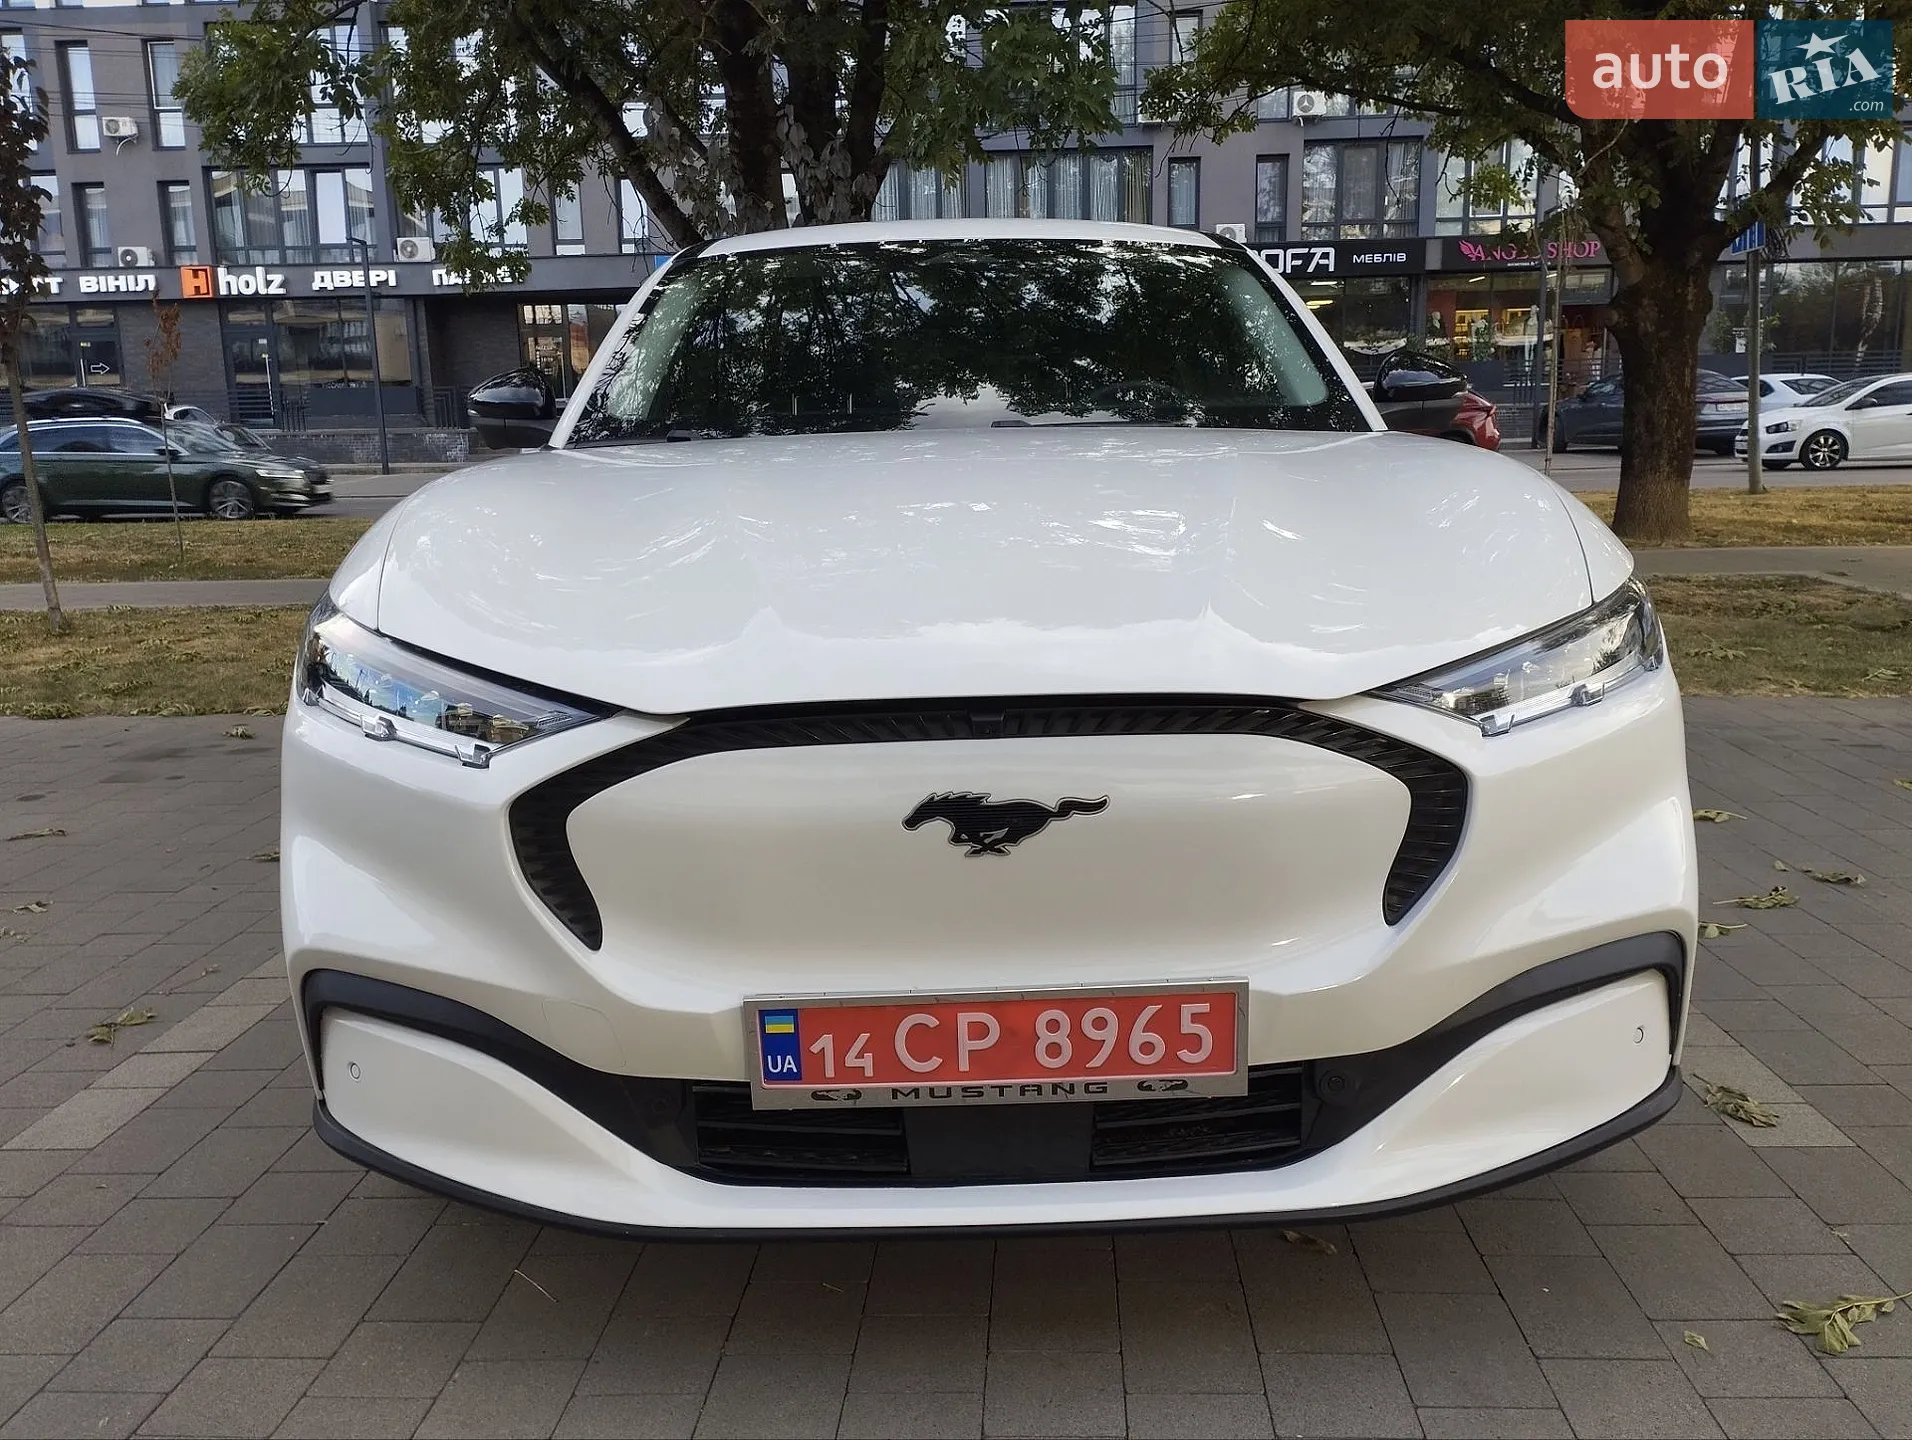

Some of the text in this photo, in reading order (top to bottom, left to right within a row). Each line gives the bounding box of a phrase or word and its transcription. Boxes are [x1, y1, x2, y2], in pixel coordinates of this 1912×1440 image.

[1250, 247, 1335, 274] OFA
[1353, 252, 1407, 264] МЕБЛІВ
[79, 275, 156, 293] ВІНІЛ
[217, 266, 286, 295] holz
[312, 269, 397, 291] ДВЕРІ
[809, 1003, 1213, 1079] 14 CP 8965
[767, 1055, 798, 1073] UA
[891, 1082, 1108, 1101] MUSTANG
